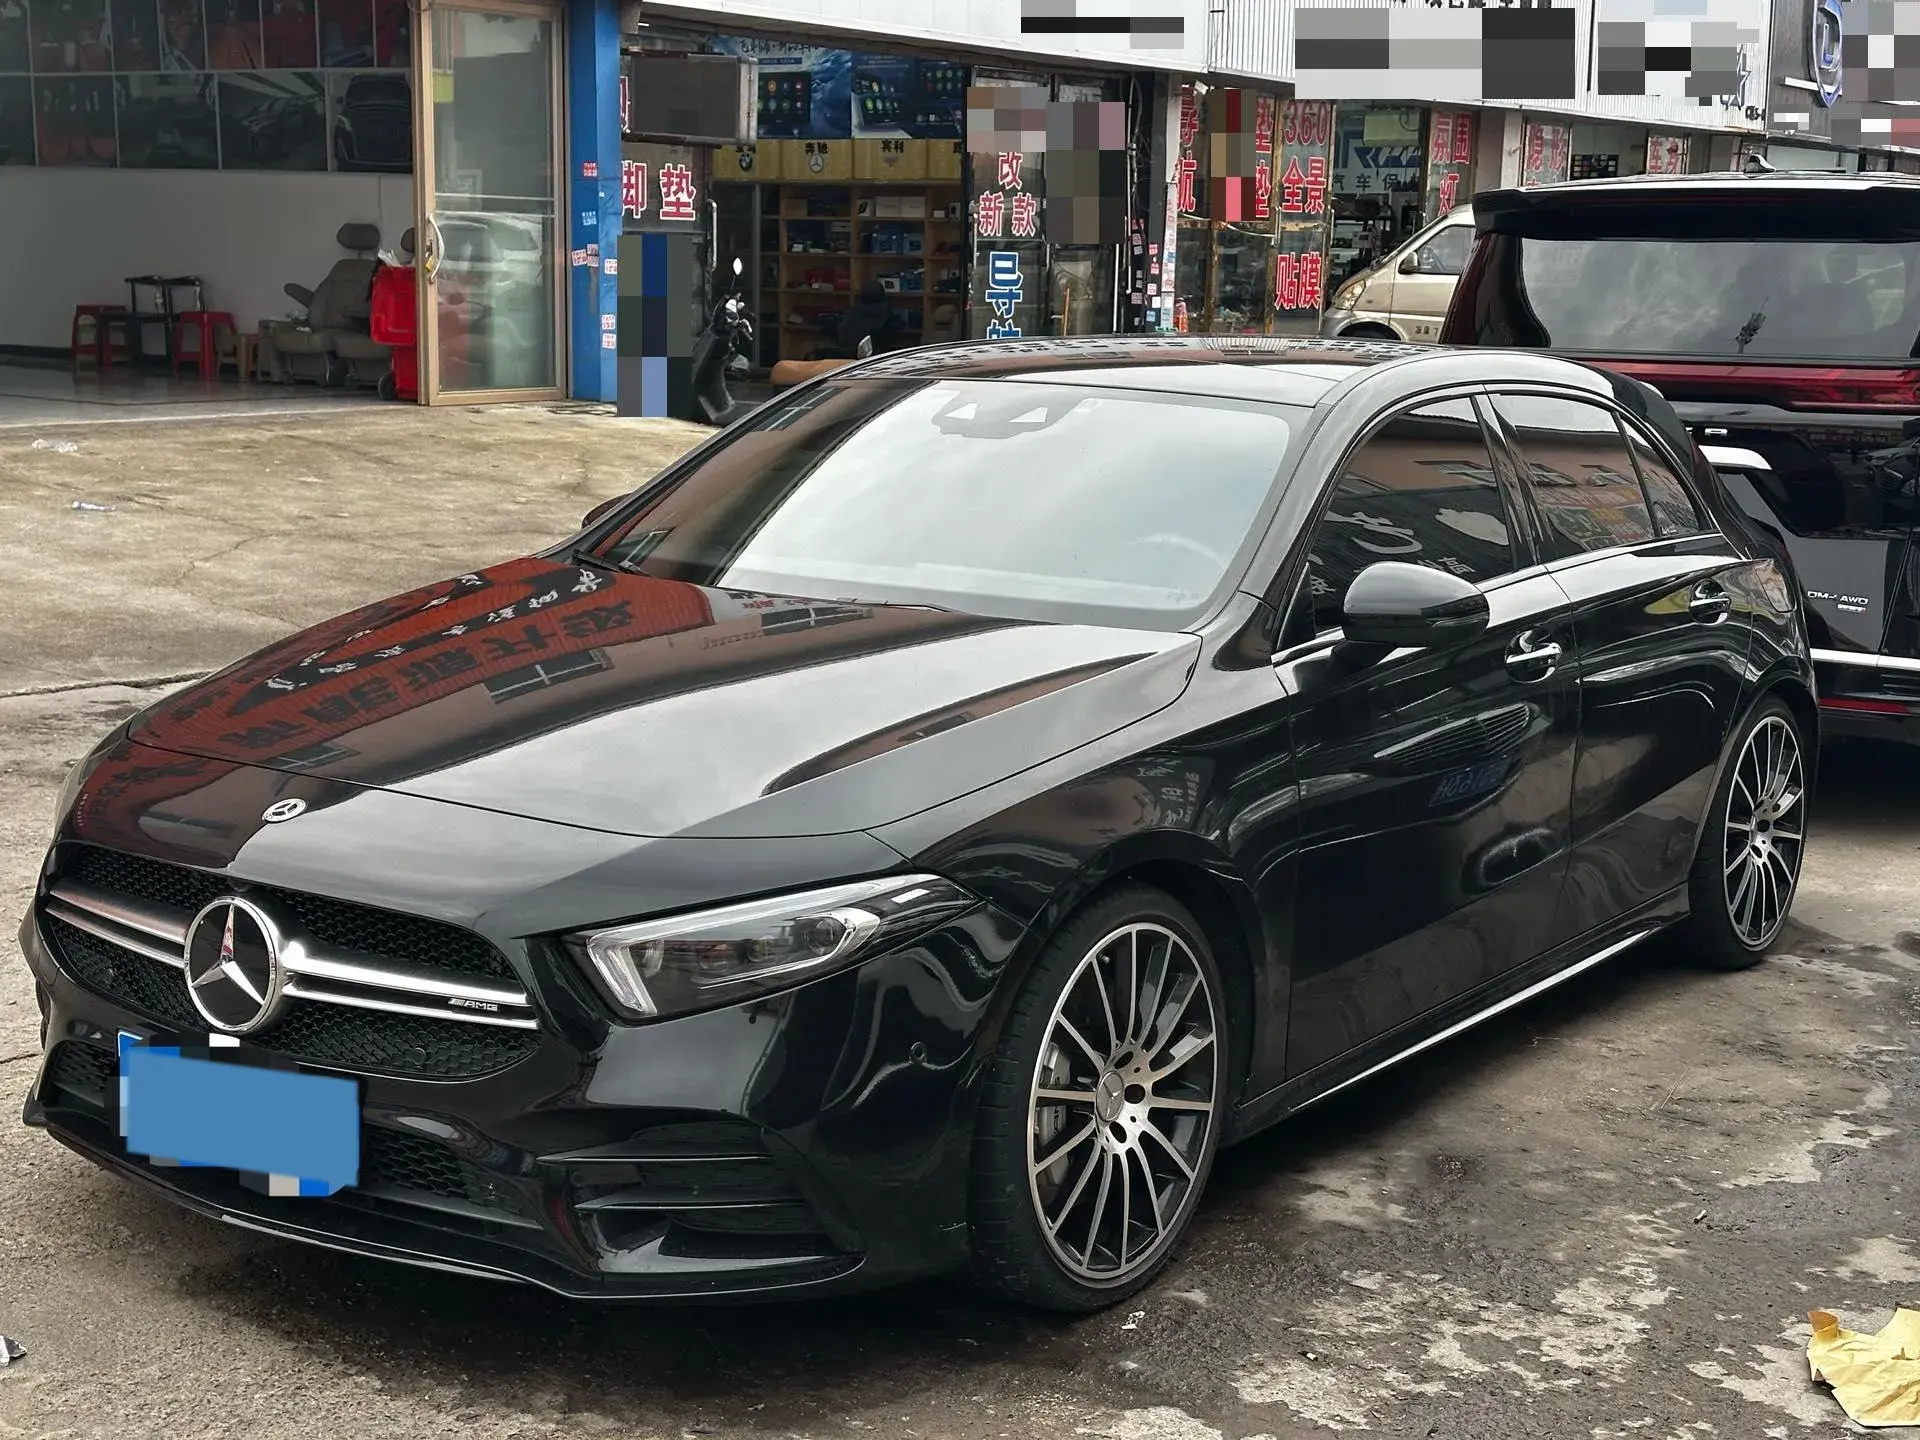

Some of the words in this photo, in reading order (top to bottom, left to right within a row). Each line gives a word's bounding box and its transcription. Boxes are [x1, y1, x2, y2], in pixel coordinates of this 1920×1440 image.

[1284, 100, 1329, 145] 360
[1281, 155, 1327, 215] 全景
[978, 190, 1037, 237] 新款
[1274, 252, 1323, 311] 贴膜
[1840, 595, 1869, 605] AWD
[464, 1000, 498, 1012] AMG
